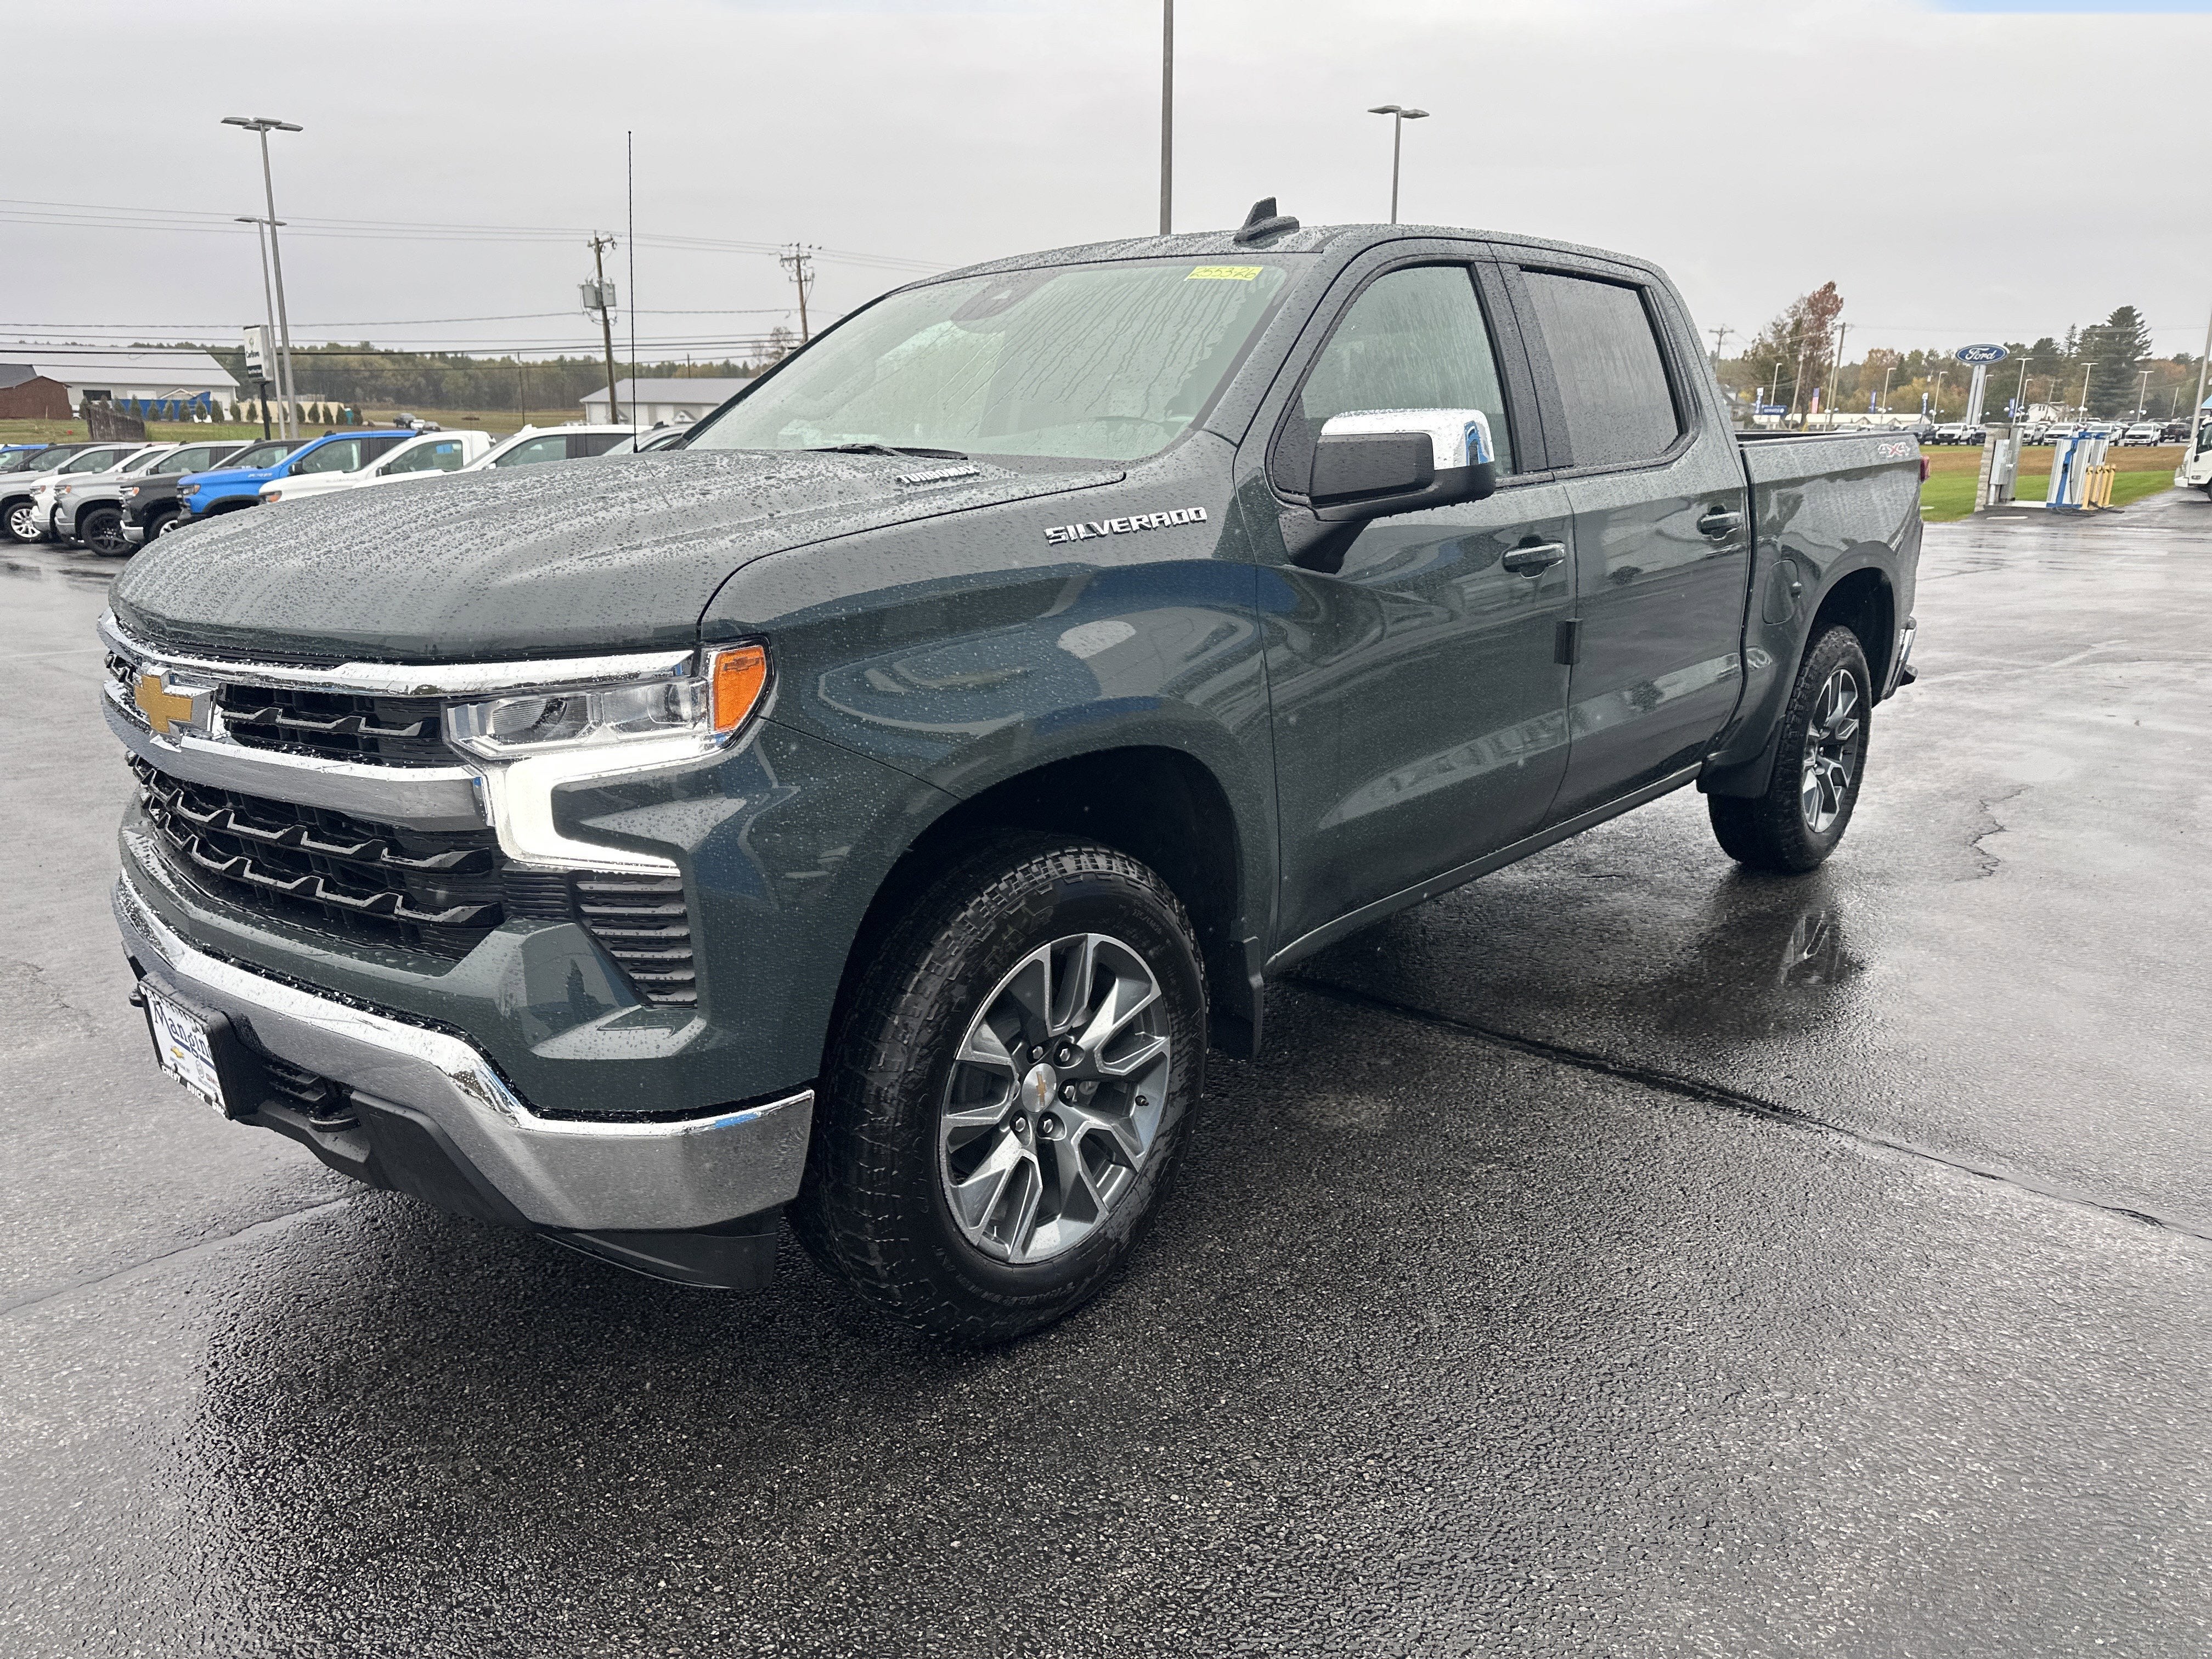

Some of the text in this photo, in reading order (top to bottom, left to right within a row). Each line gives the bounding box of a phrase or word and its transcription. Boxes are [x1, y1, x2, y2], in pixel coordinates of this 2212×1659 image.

[1189, 267, 1260, 279] 2553-26
[1965, 347, 1997, 360] Ford
[895, 464, 981, 485] TURBOMAX
[1043, 506, 1208, 546] SILVERADO
[161, 1065, 181, 1084] CHEVY
[187, 1081, 205, 1102] BUICK
[212, 1101, 226, 1119] GMC
